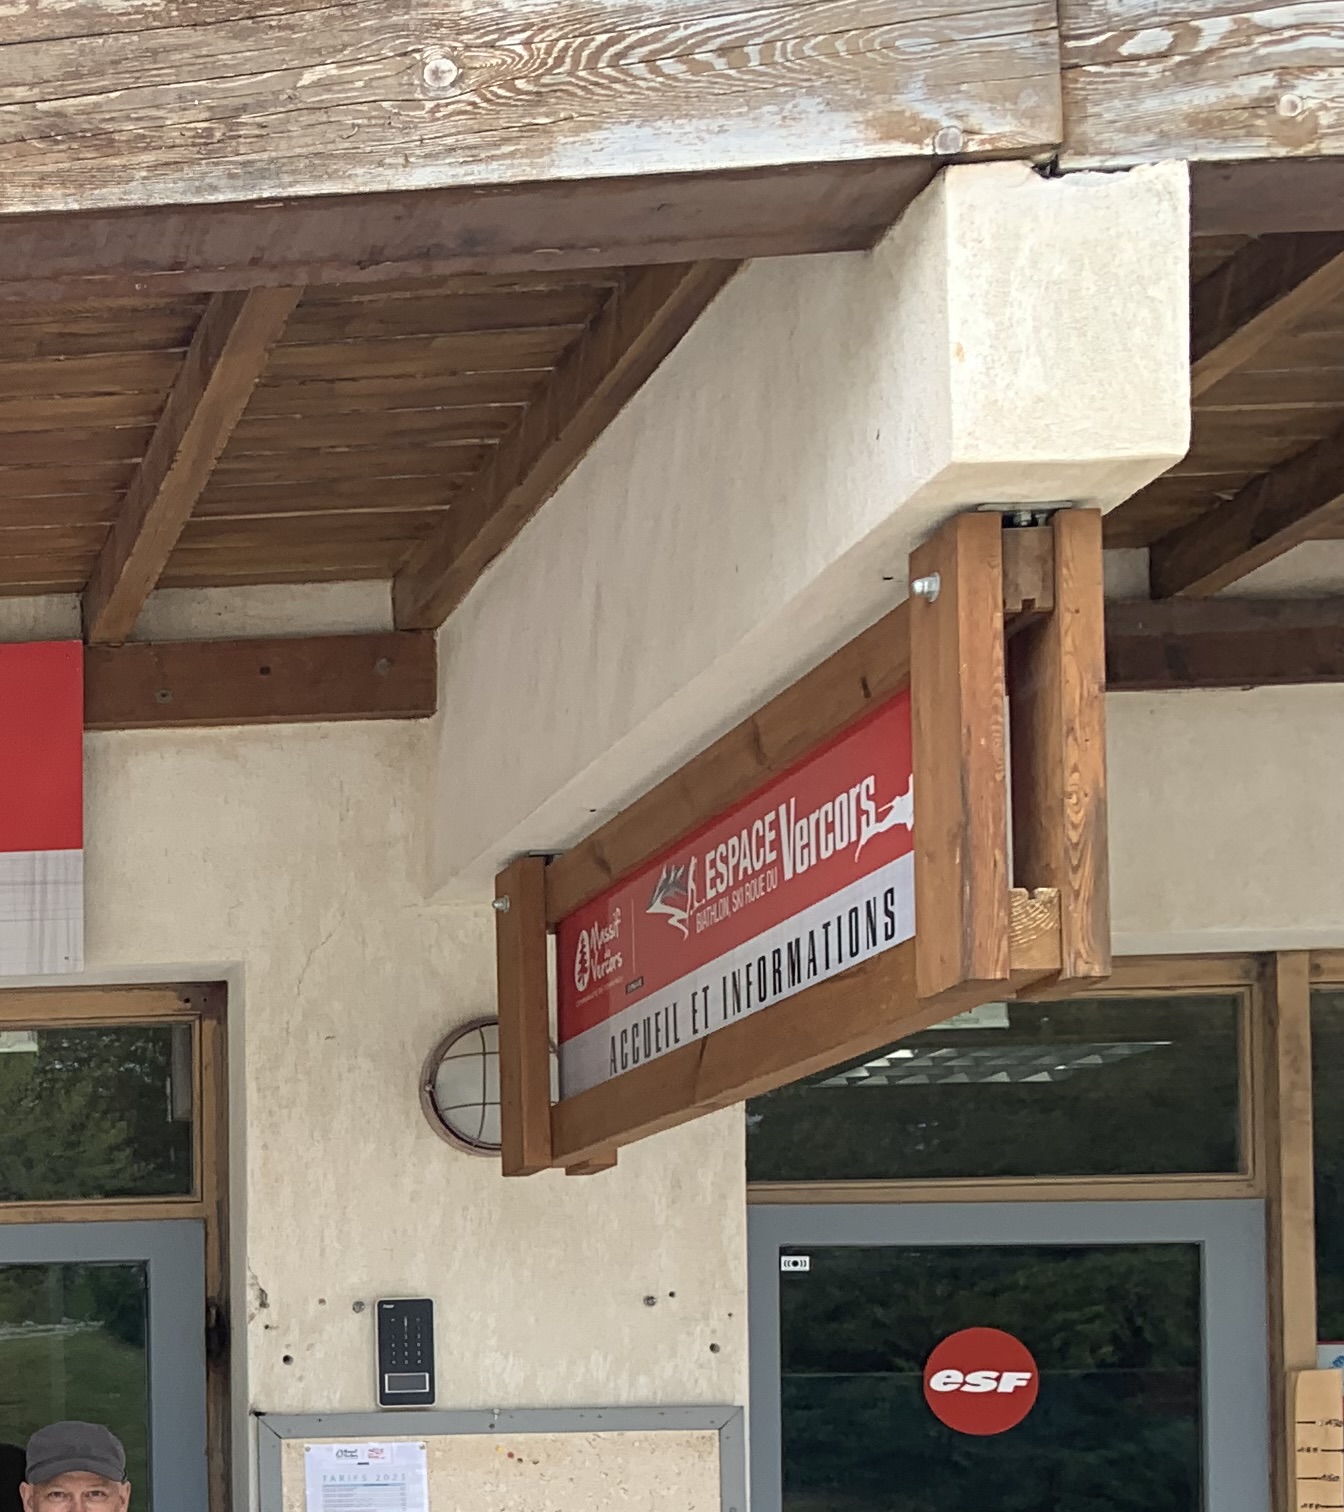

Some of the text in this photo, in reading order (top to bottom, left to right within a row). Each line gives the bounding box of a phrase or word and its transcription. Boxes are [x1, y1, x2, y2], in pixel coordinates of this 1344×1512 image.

[705, 775, 876, 900] ESPACE Vercors
[696, 867, 778, 934] BIATHLON, SKI ROUE DU
[610, 1002, 680, 1076] ACCUEIL
[692, 985, 710, 1034] ET
[722, 888, 895, 1020] INFORMATIONS
[322, 1474, 367, 1482] TARIFS
